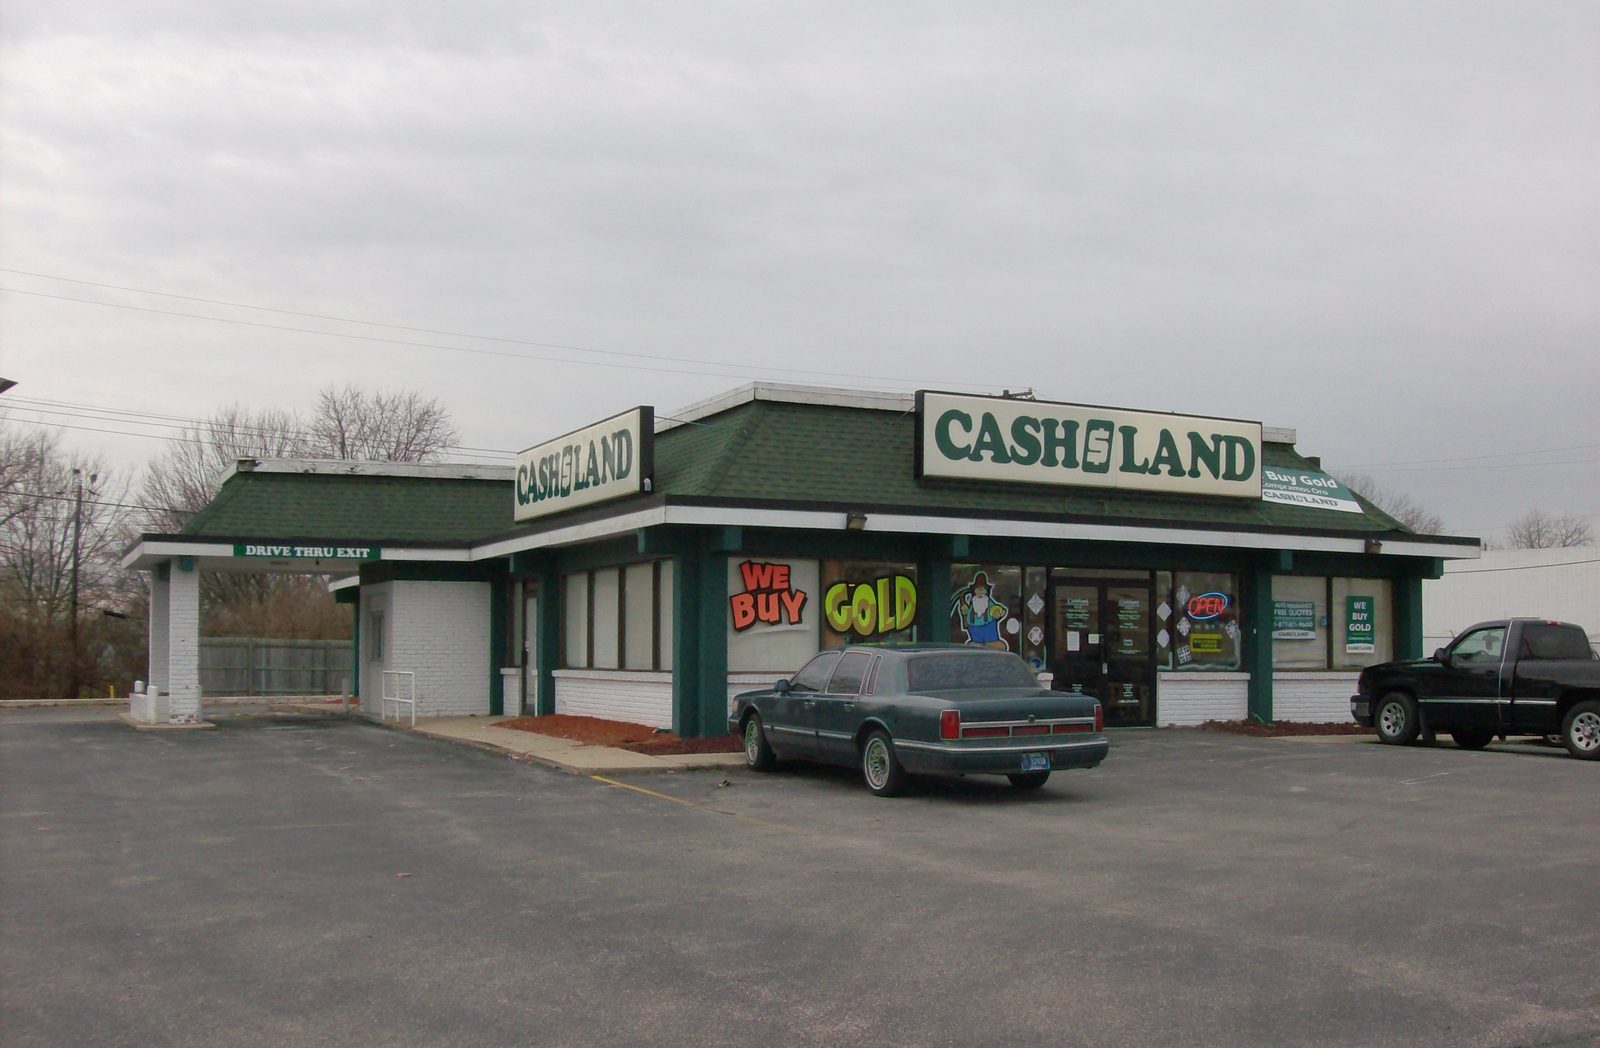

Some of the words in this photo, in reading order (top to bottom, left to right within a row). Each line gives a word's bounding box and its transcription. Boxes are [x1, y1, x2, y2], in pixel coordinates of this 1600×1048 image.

[1264, 470, 1297, 485] Buy
[1300, 475, 1338, 488] Gold
[245, 545, 290, 557] DRIVE
[294, 546, 333, 557] THRU
[335, 547, 370, 558] EXIT
[741, 559, 791, 593] WE
[730, 588, 807, 631] BUY
[825, 575, 917, 636] GOLD
[1188, 596, 1225, 615] OPEN
[1354, 601, 1366, 609] WE
[1352, 612, 1367, 620] BUY
[1349, 623, 1371, 631] GOLD
